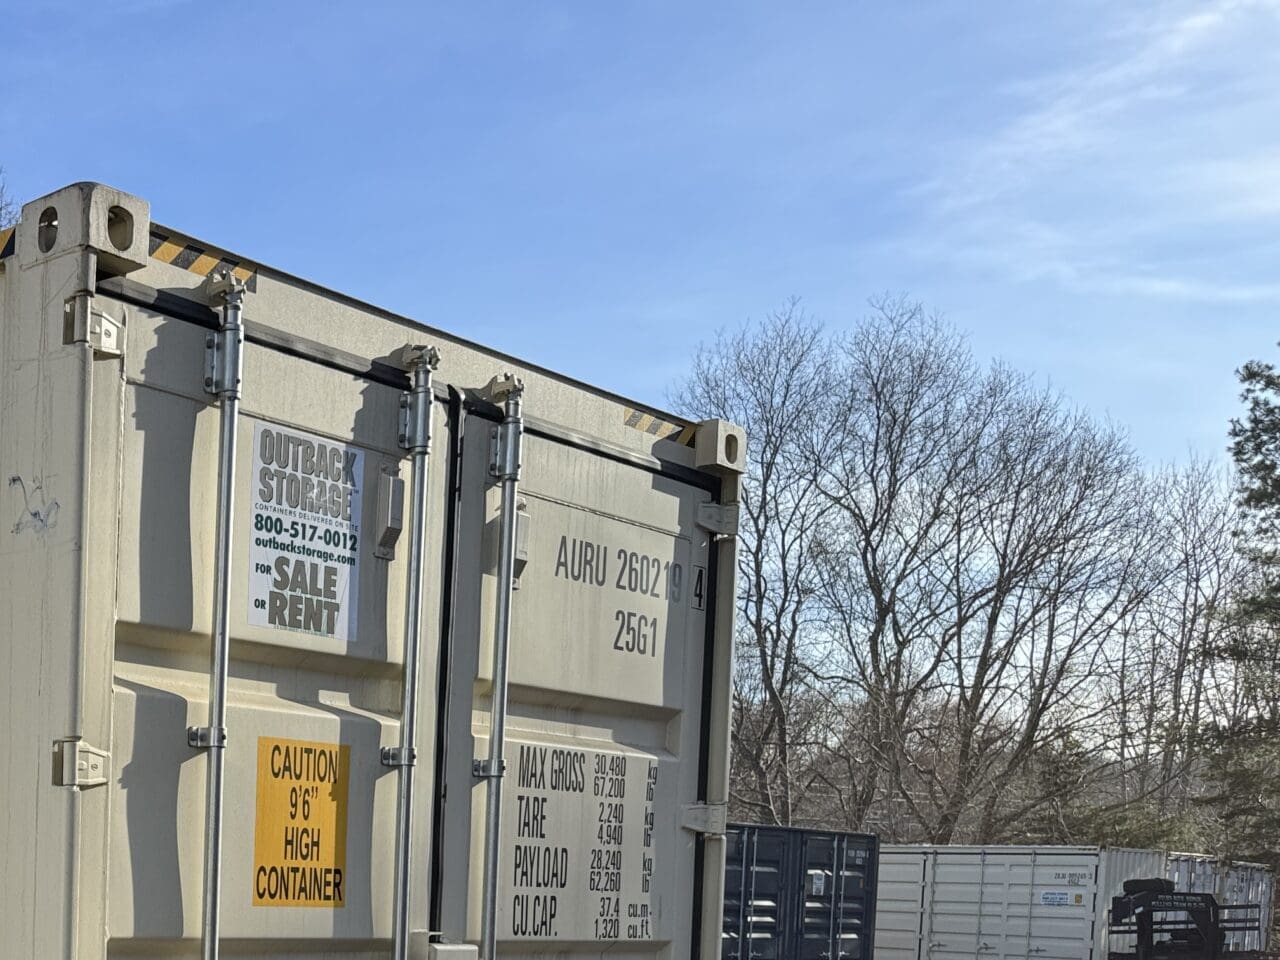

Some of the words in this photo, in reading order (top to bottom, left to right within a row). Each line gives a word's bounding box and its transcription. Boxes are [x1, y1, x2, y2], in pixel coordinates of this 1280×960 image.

[260, 428, 357, 487] OUTBACK
[255, 502, 297, 517] CONTAINERS
[299, 512, 333, 526] DELIVERED
[259, 466, 352, 521] STORAGE
[254, 514, 358, 552] 800-517-0012
[255, 537, 356, 566] outbackstorage.com
[255, 563, 272, 575] FOR
[273, 556, 338, 600] SALE
[554, 535, 608, 587] AURU
[616, 548, 682, 603] 260219
[694, 568, 704, 608] 4
[254, 599, 266, 610] OR
[267, 591, 340, 635] RENT
[613, 609, 658, 658] 25G1
[271, 744, 338, 784] CAUTION
[518, 745, 547, 789] MAX
[550, 749, 586, 793] GROSS
[594, 754, 627, 777] 30,480
[648, 760, 658, 785] kg
[593, 775, 626, 799] 67,200
[646, 781, 654, 801] lb
[517, 795, 547, 839] TARE
[598, 802, 624, 824] 2,240
[644, 806, 654, 831] kg
[597, 823, 623, 846] 4,940
[643, 827, 651, 848] lb
[284, 826, 320, 862] HIGH
[256, 865, 343, 901] CONTAINER
[513, 845, 568, 889] PAYLOAD
[590, 849, 622, 871] 28,240
[642, 852, 652, 876] kg
[589, 871, 621, 893] 62,260
[642, 873, 650, 893] lb
[512, 894, 558, 937] CU.CAP.
[599, 897, 620, 918] 37.4
[594, 918, 620, 940] 1,320
